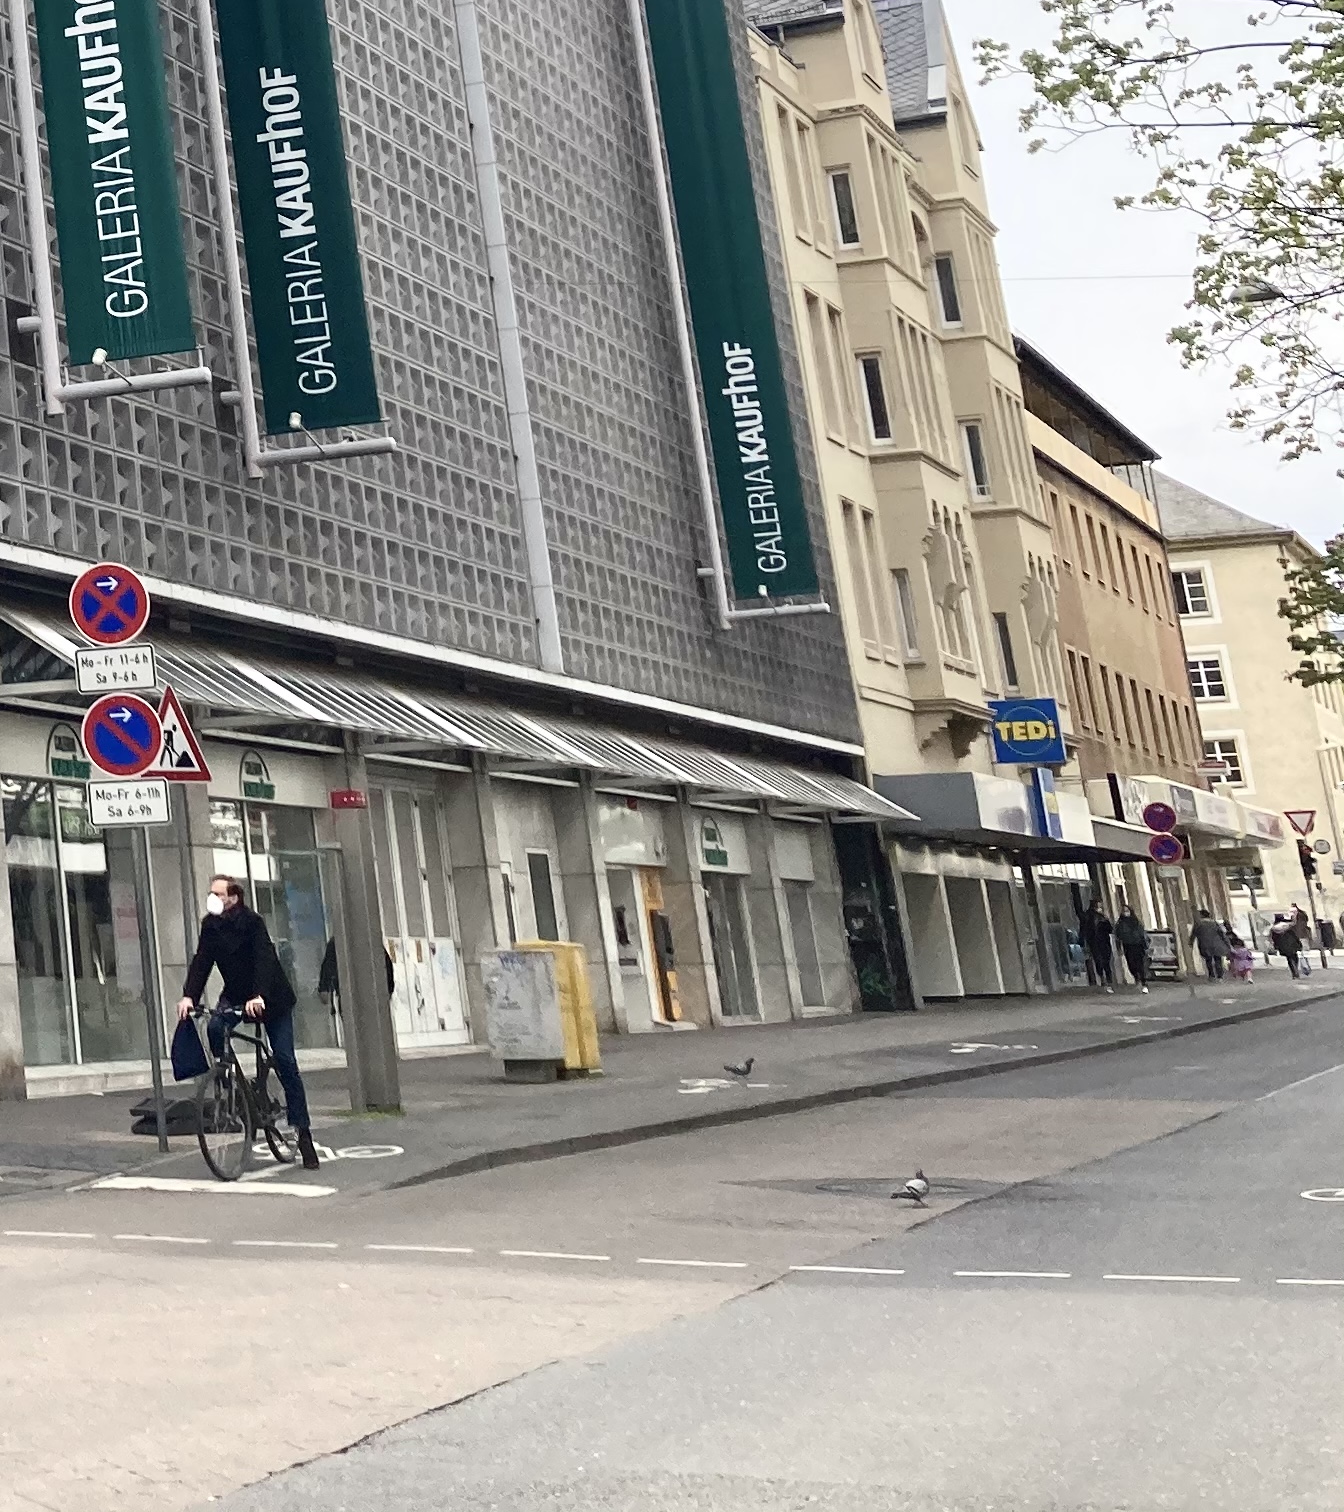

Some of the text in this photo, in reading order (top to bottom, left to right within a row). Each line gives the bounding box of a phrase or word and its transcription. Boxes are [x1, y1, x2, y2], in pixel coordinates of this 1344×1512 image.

[89, 144, 149, 318] GALERIA
[257, 64, 338, 396] GALERIA KAUFhOF
[721, 341, 787, 573] GALERIA KAUFhOF
[96, 673, 107, 684] Sa
[994, 719, 1057, 742] TEDi
[95, 787, 161, 801] Mo-Fr 6-11h
[107, 804, 152, 817] Sa 6-9h
